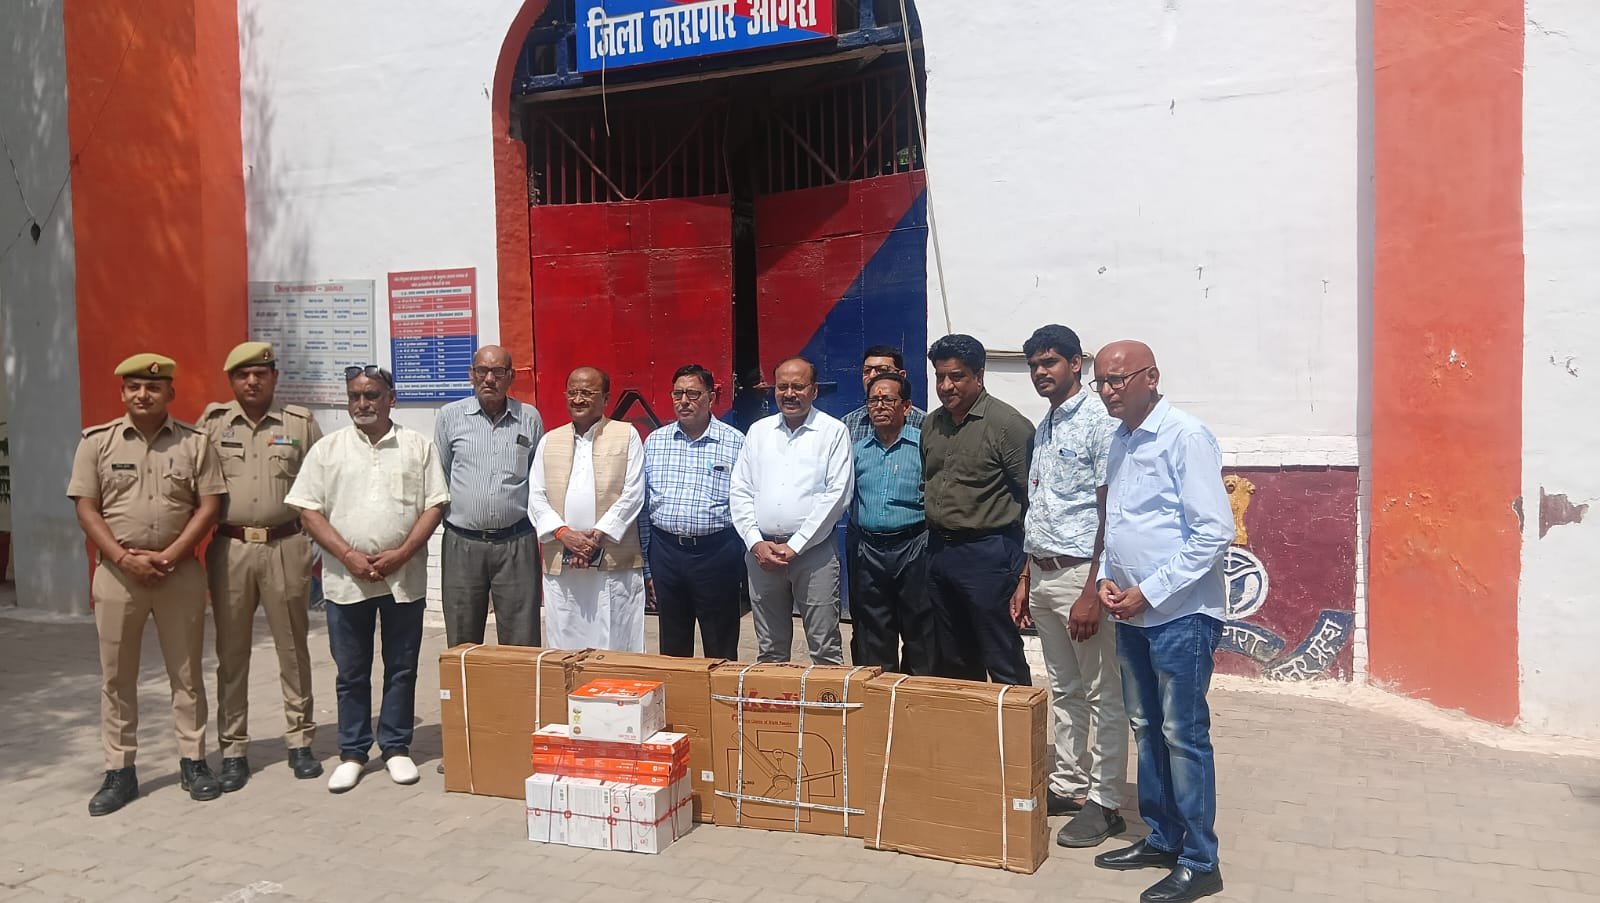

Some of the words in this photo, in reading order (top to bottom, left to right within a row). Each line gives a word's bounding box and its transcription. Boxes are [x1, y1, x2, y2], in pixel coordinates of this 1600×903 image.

[587, 7, 644, 59] जिला
[650, 0, 737, 49] कारागार
[1297, 618, 1343, 665] प्रदेश
